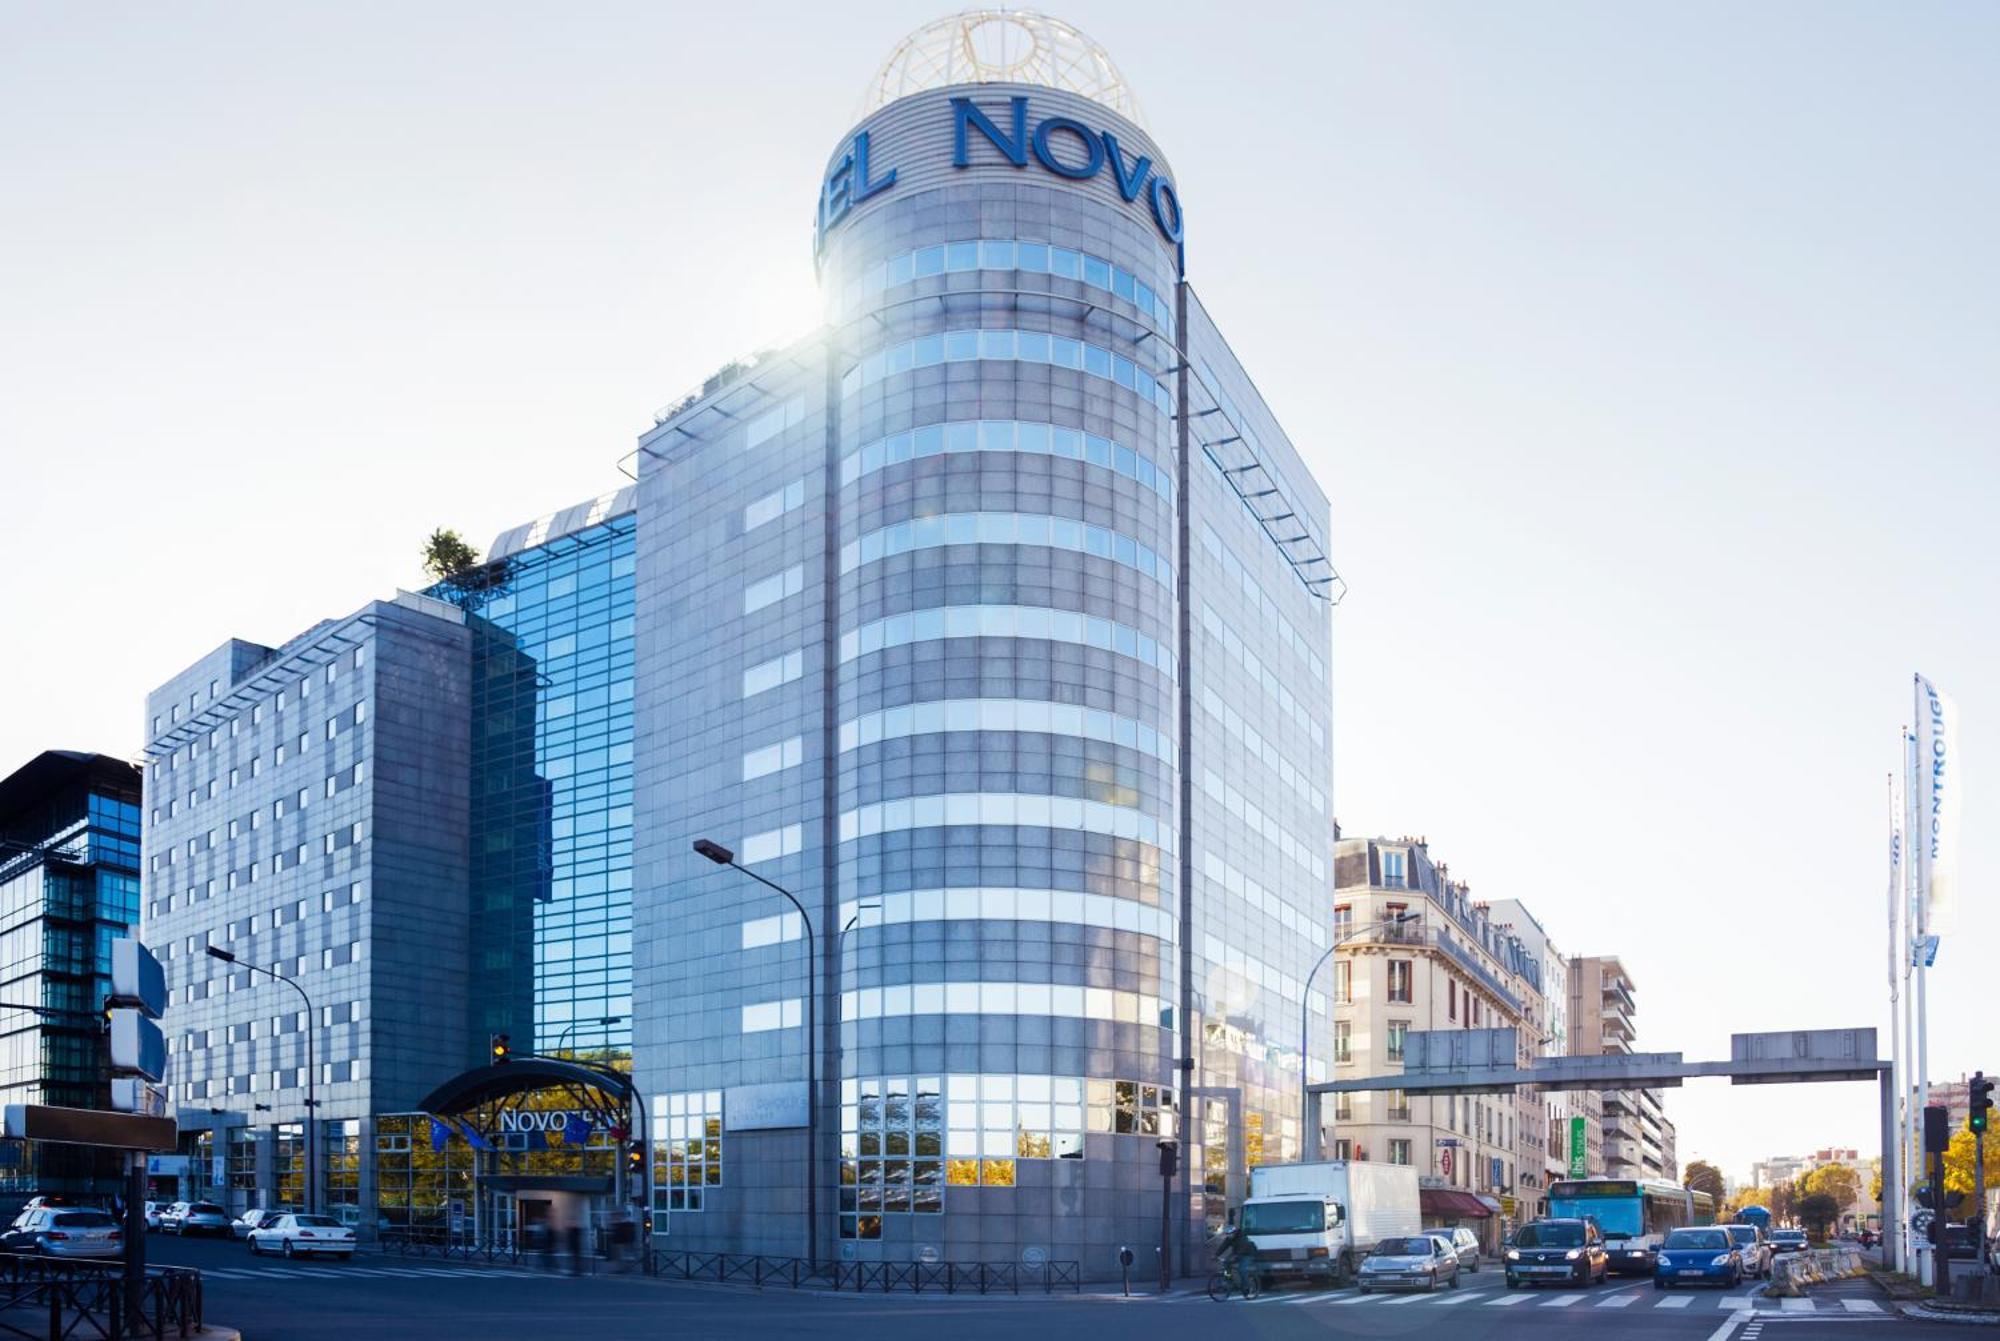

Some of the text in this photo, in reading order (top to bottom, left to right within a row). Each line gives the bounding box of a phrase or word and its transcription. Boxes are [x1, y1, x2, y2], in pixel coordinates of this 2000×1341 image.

[815, 96, 1185, 276] EL NOVO
[1571, 1156, 1585, 1175] ibis
